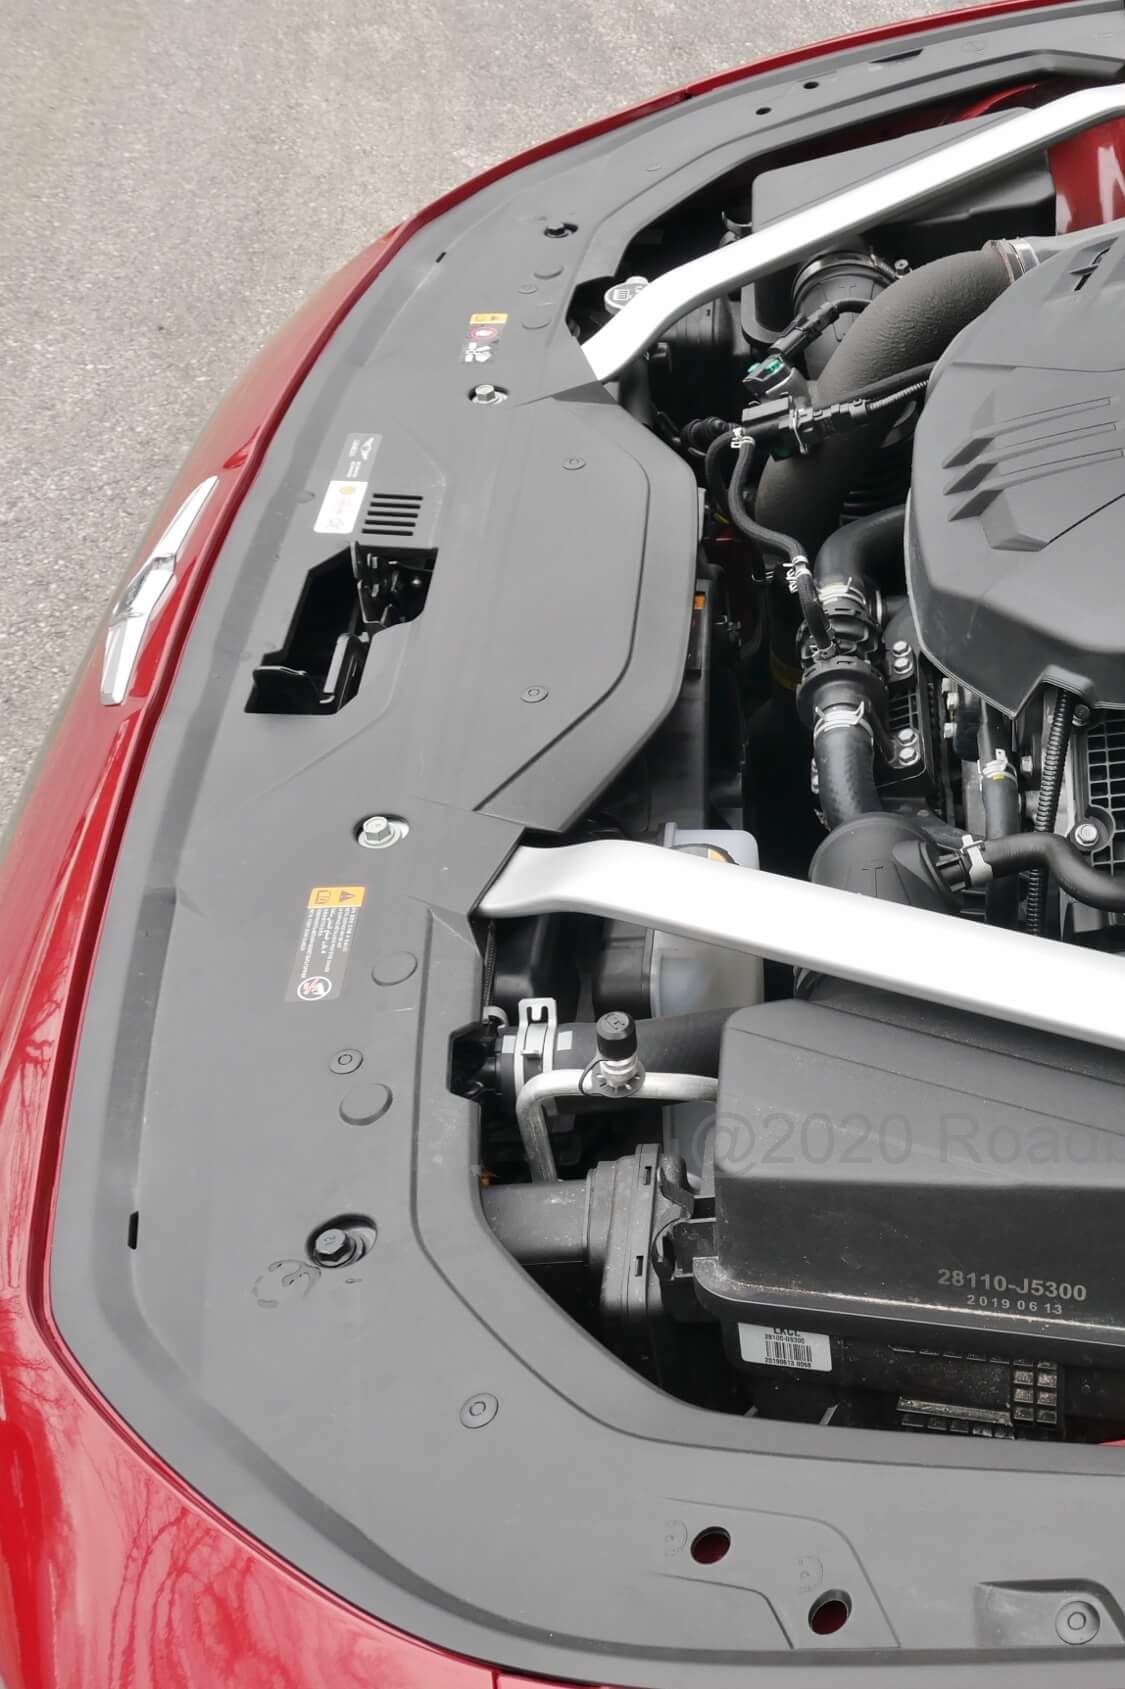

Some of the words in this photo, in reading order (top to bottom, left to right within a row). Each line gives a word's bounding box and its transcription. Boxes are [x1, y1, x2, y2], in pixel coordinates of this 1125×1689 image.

[937, 1268, 1088, 1301] 28110-J5300
[967, 1294, 1010, 1309] 2019
[1017, 1299, 1038, 1311] 06
[1044, 1303, 1062, 1315] 13
